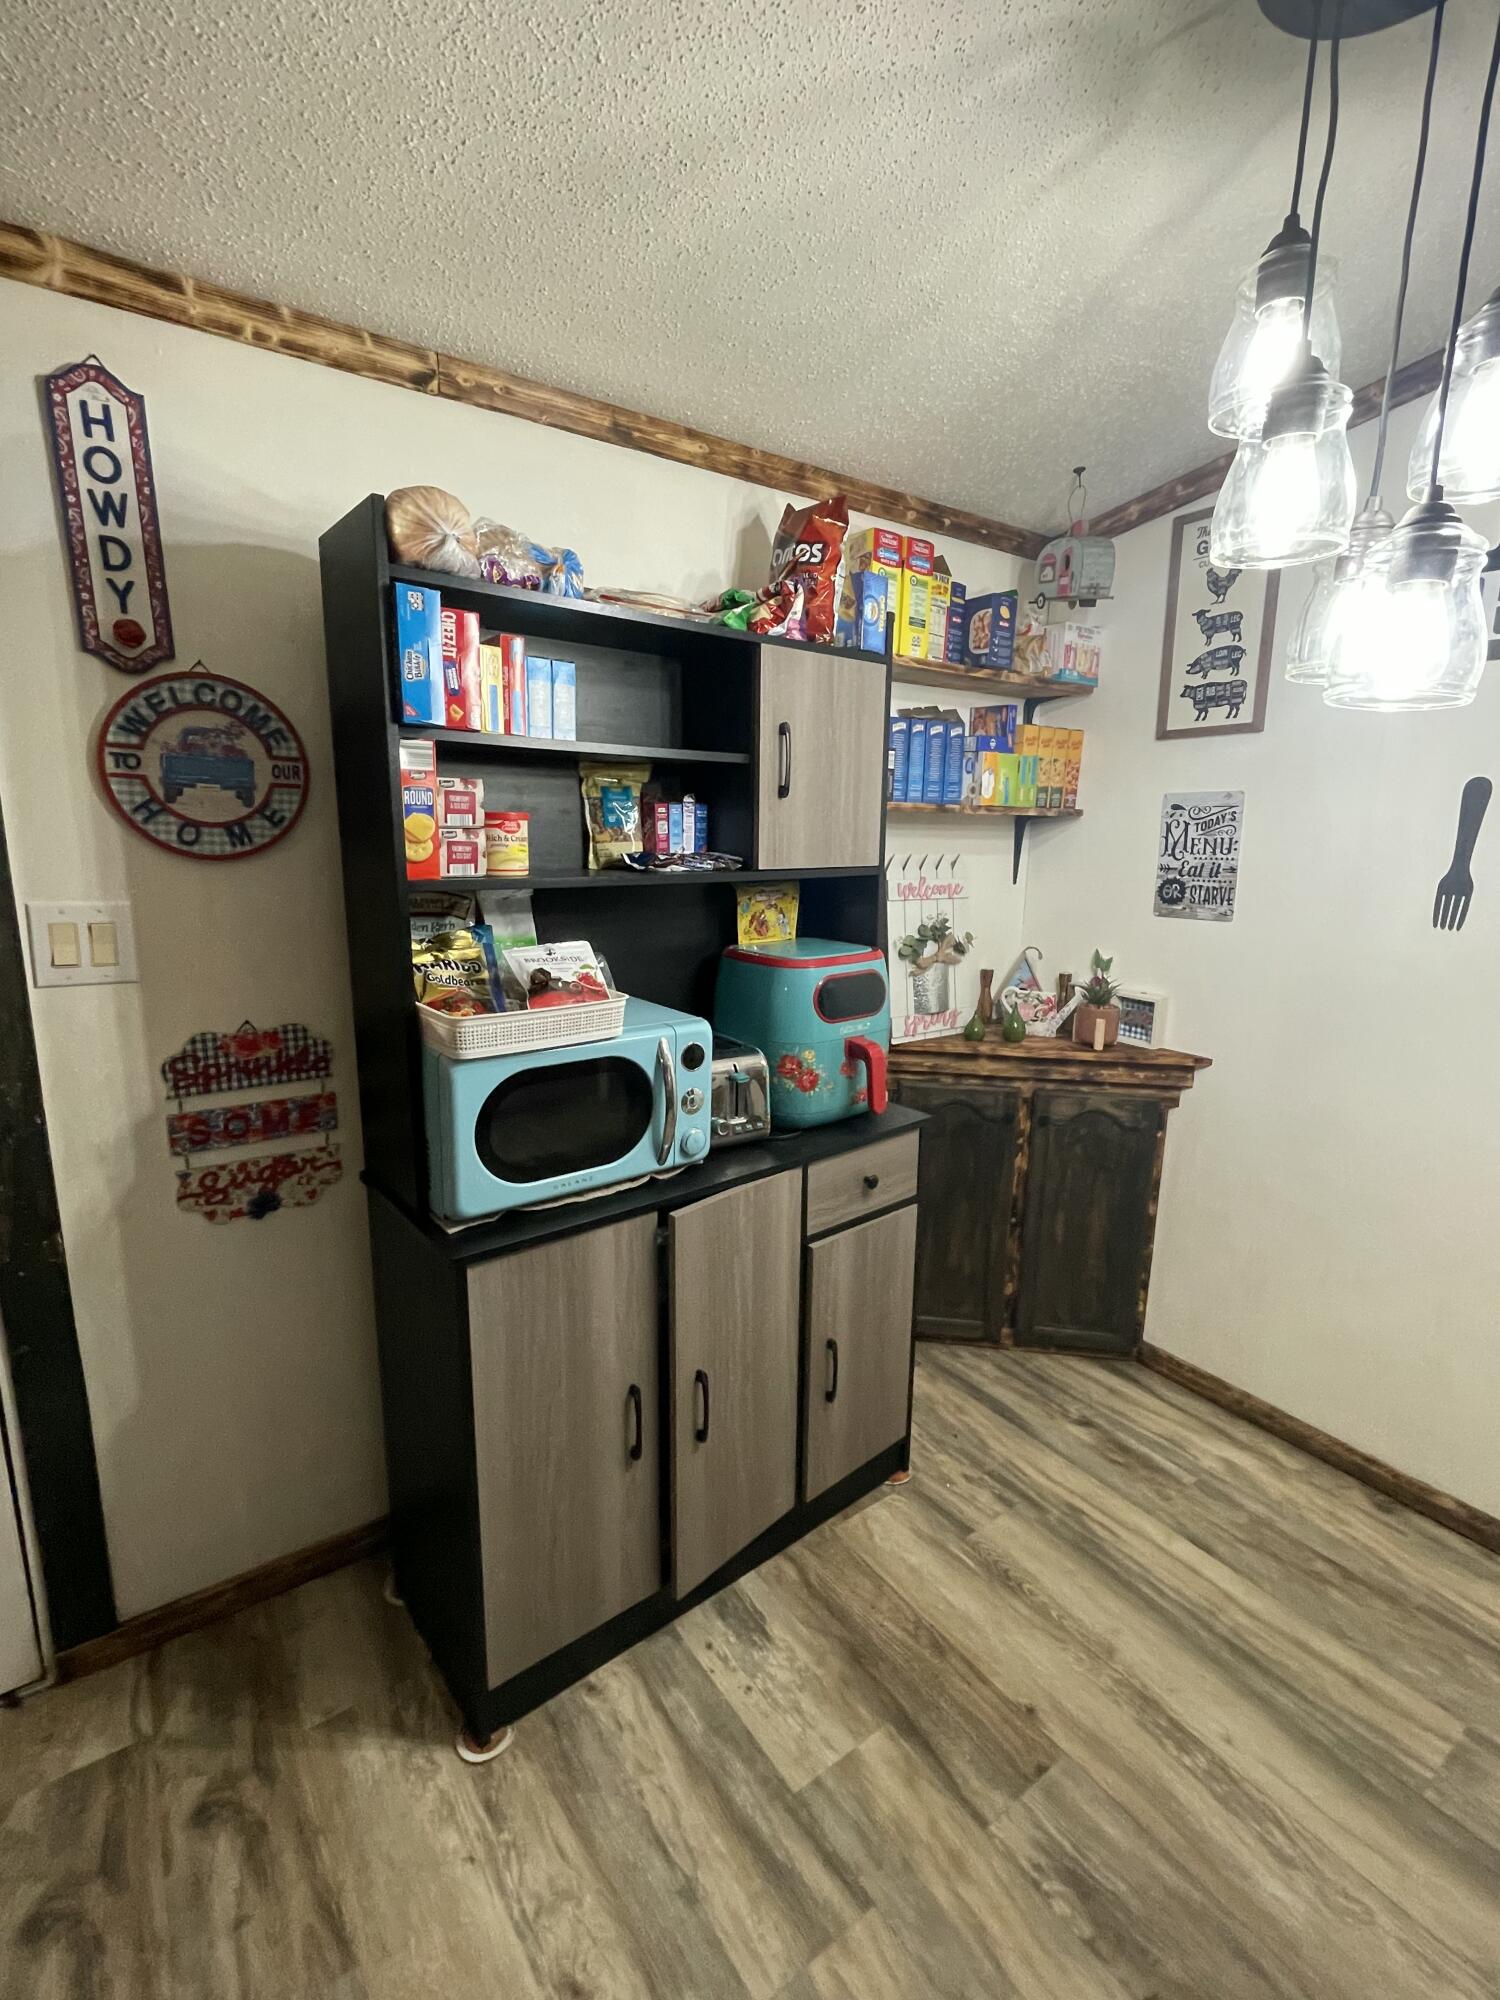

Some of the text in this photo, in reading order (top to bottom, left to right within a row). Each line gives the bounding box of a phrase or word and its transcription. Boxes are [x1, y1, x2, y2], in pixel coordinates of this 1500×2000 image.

[79, 399, 135, 615] HOWDY
[115, 682, 290, 755] WELCOME
[108, 751, 142, 771] TO
[271, 763, 302, 781] OUR
[403, 790, 433, 806] ROUND
[132, 789, 287, 848] HOME
[1194, 810, 1238, 833] TODAY'S
[1178, 860, 1222, 879] Eat it
[1162, 883, 1235, 907] OR STARVE
